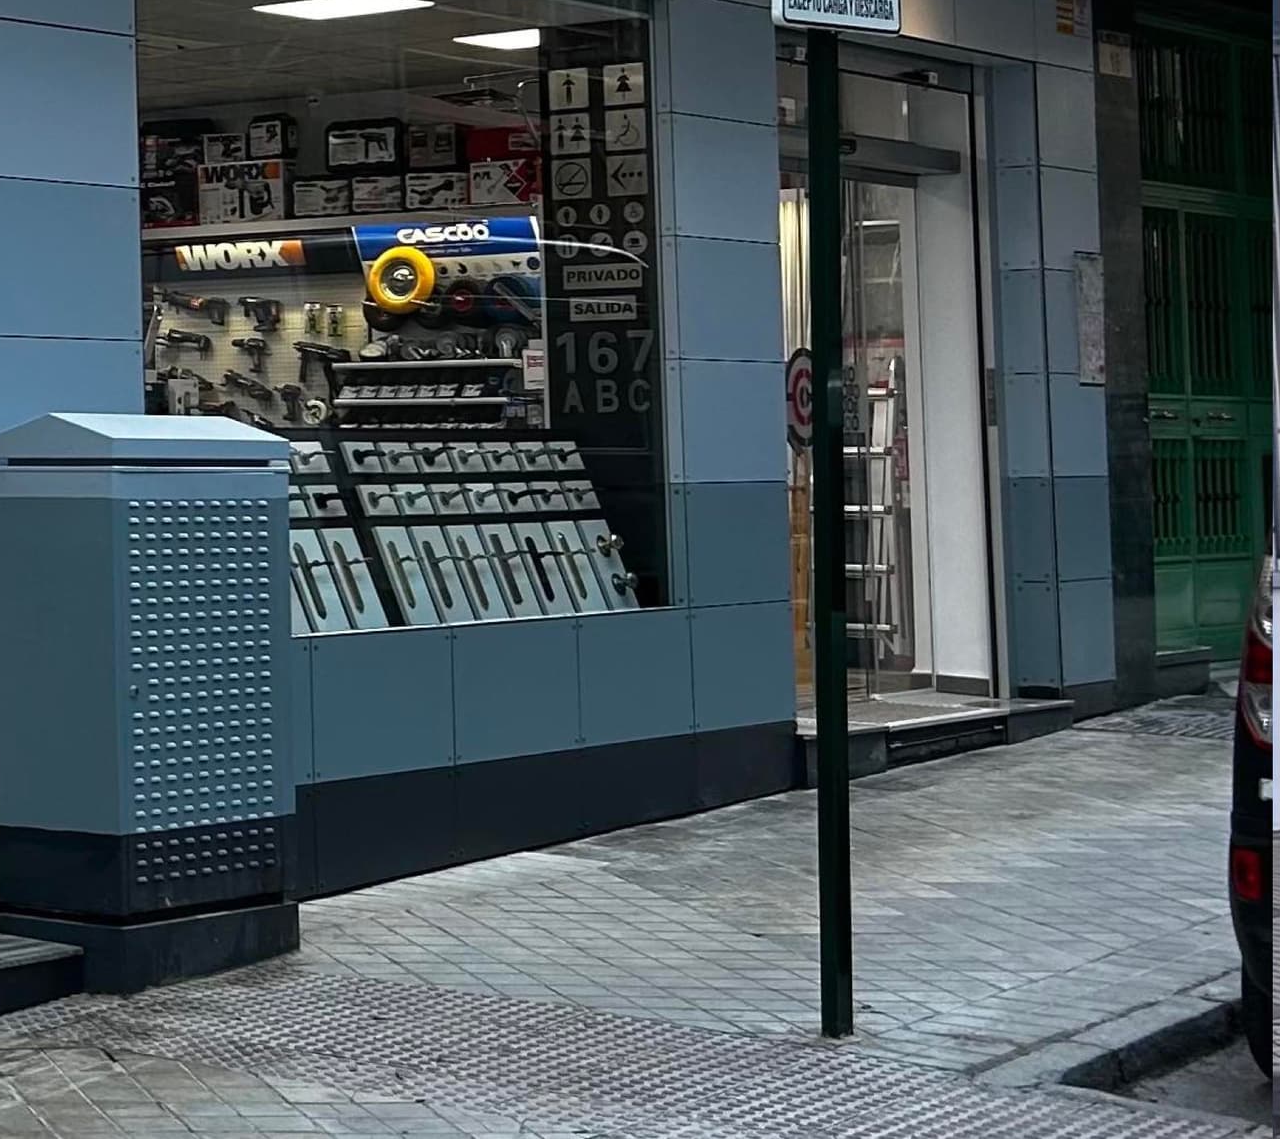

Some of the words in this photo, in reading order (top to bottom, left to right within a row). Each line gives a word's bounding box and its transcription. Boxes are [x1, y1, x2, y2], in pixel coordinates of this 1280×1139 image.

[177, 240, 289, 271] WORX
[566, 268, 640, 283] PRIVADO
[574, 302, 634, 315] SALIDA
